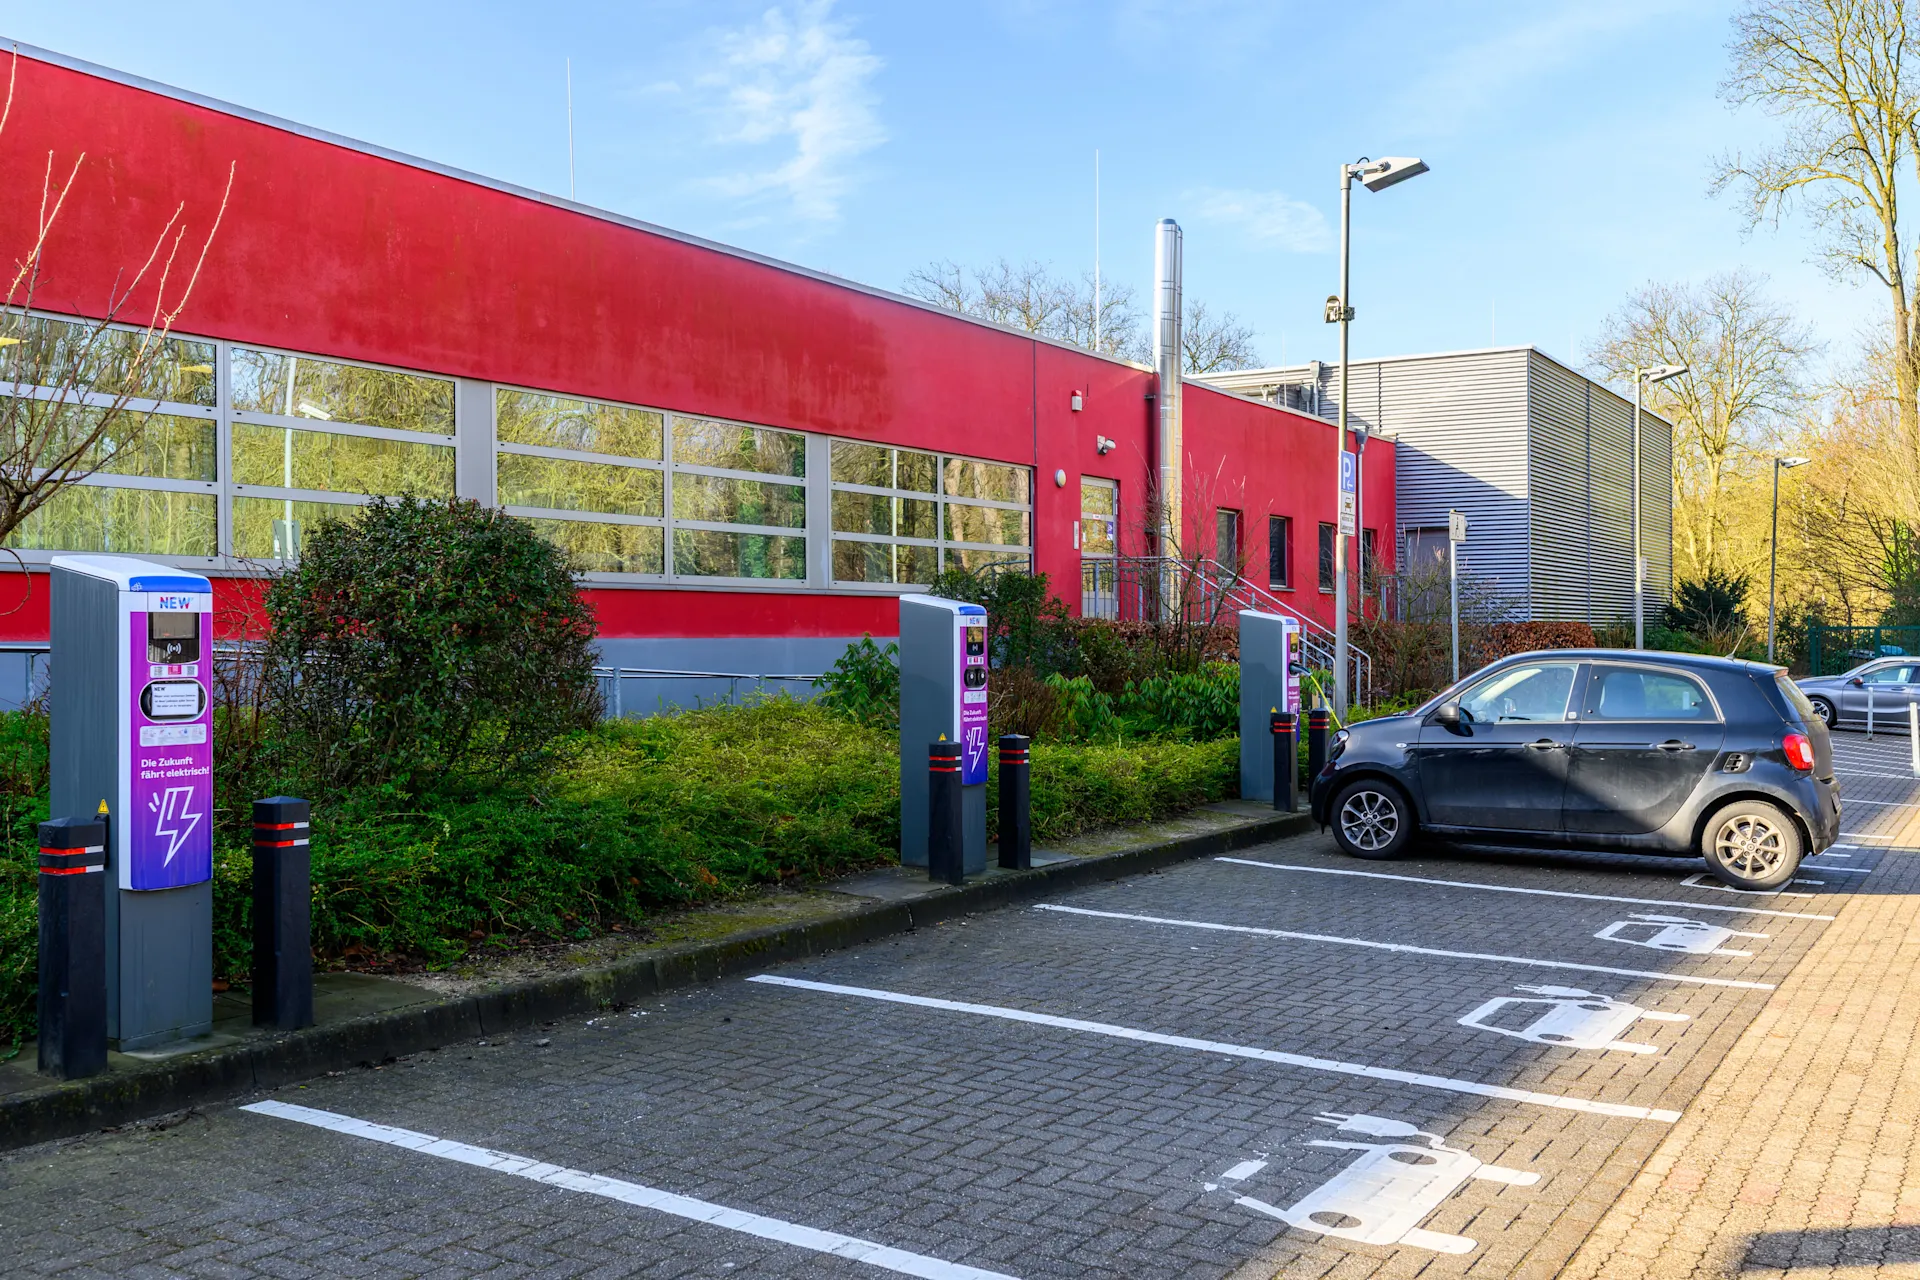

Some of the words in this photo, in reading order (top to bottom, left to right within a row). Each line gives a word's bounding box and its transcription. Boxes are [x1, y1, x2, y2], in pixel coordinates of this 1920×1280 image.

[1343, 457, 1351, 489] P
[160, 596, 191, 609] NEW
[141, 759, 157, 768] Die
[158, 756, 193, 766] Zukunft
[141, 770, 165, 779] fährt
[166, 766, 210, 777] elektrisch!
